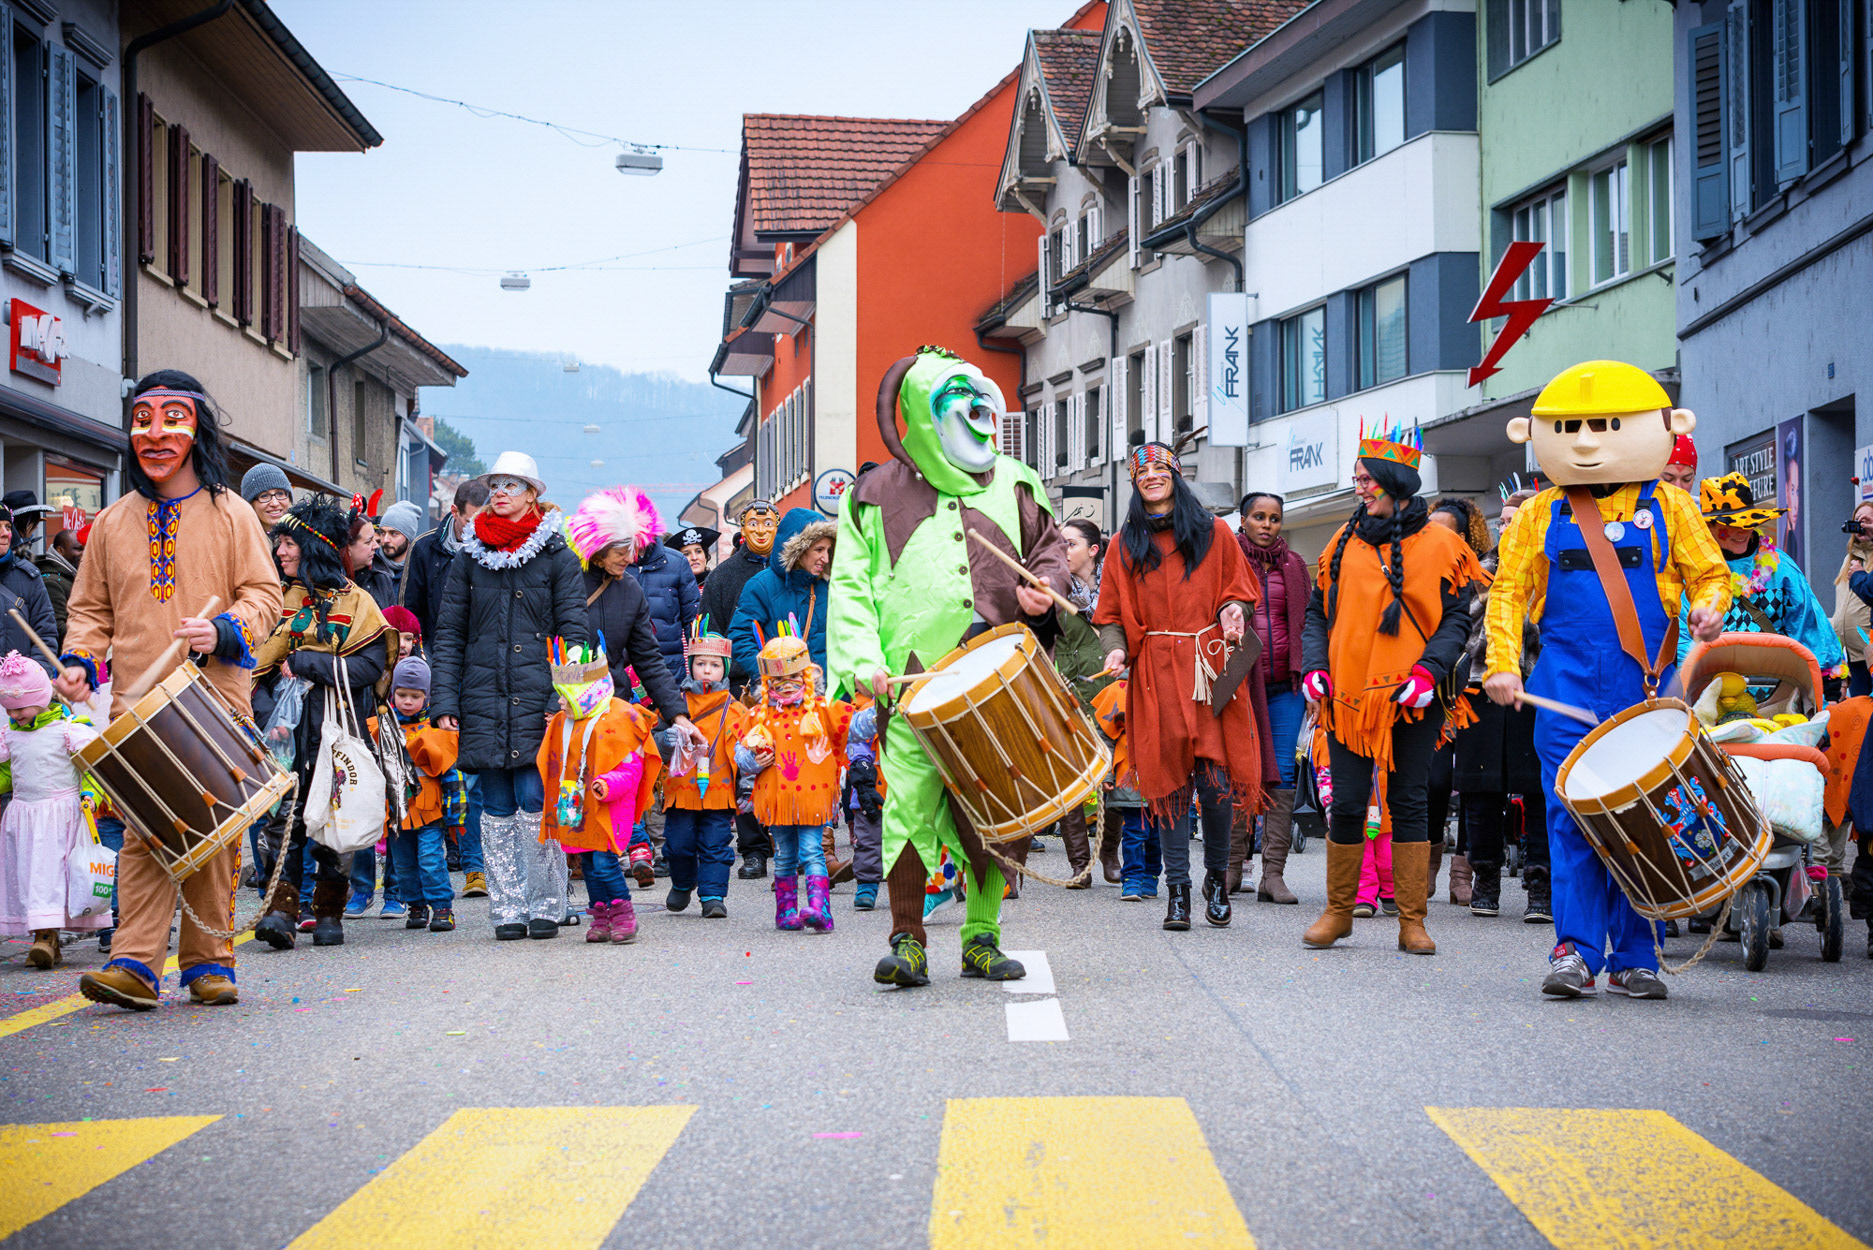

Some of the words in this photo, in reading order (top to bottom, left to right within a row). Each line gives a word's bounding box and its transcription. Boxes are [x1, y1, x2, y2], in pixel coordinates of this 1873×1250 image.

[1225, 326, 1239, 398] FRANK
[1290, 442, 1323, 472] FRANK
[1735, 456, 1749, 476] ART
[1750, 447, 1774, 474] STYLE
